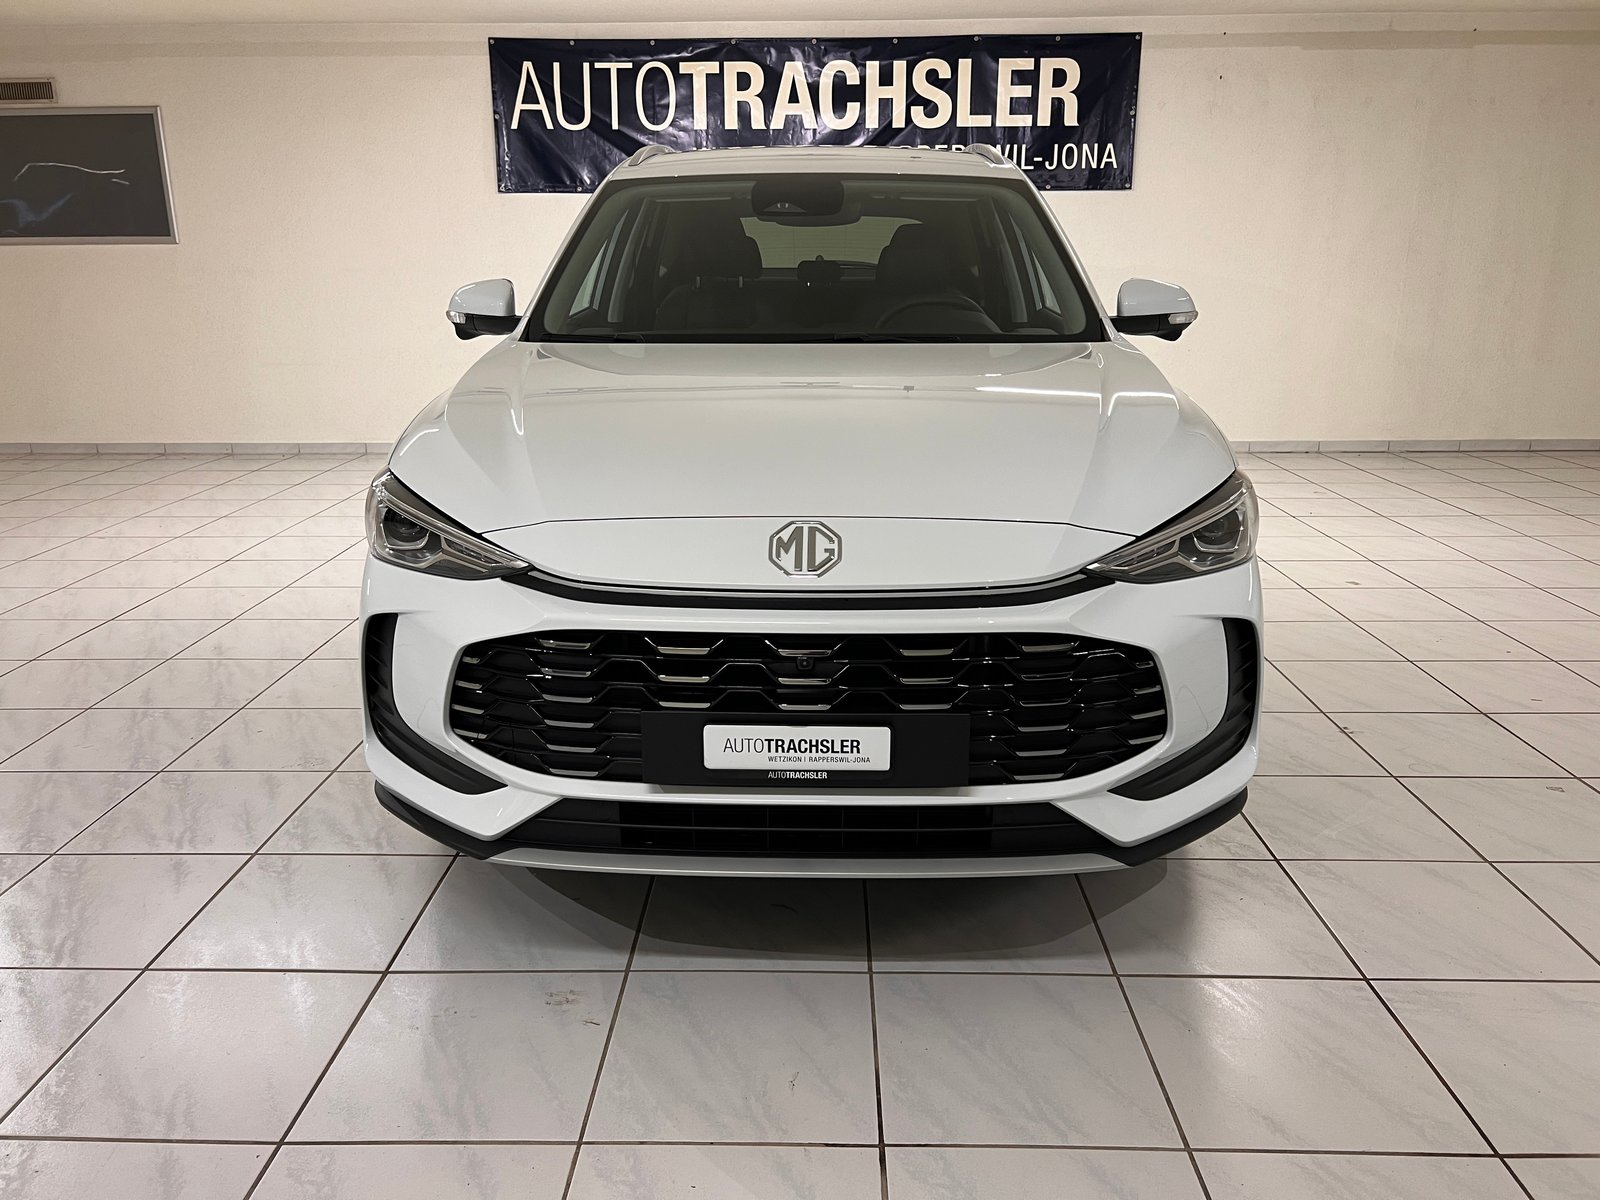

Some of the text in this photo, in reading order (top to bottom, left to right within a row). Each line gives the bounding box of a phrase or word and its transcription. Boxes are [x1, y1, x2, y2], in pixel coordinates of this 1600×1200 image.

[510, 57, 1081, 131] AUTOTRACHSLER
[775, 526, 835, 572] MG
[723, 737, 861, 754] AUTOTRACHSLER
[768, 755, 802, 763] WETZIKON
[768, 771, 828, 779] AUTOTRACHSLER
